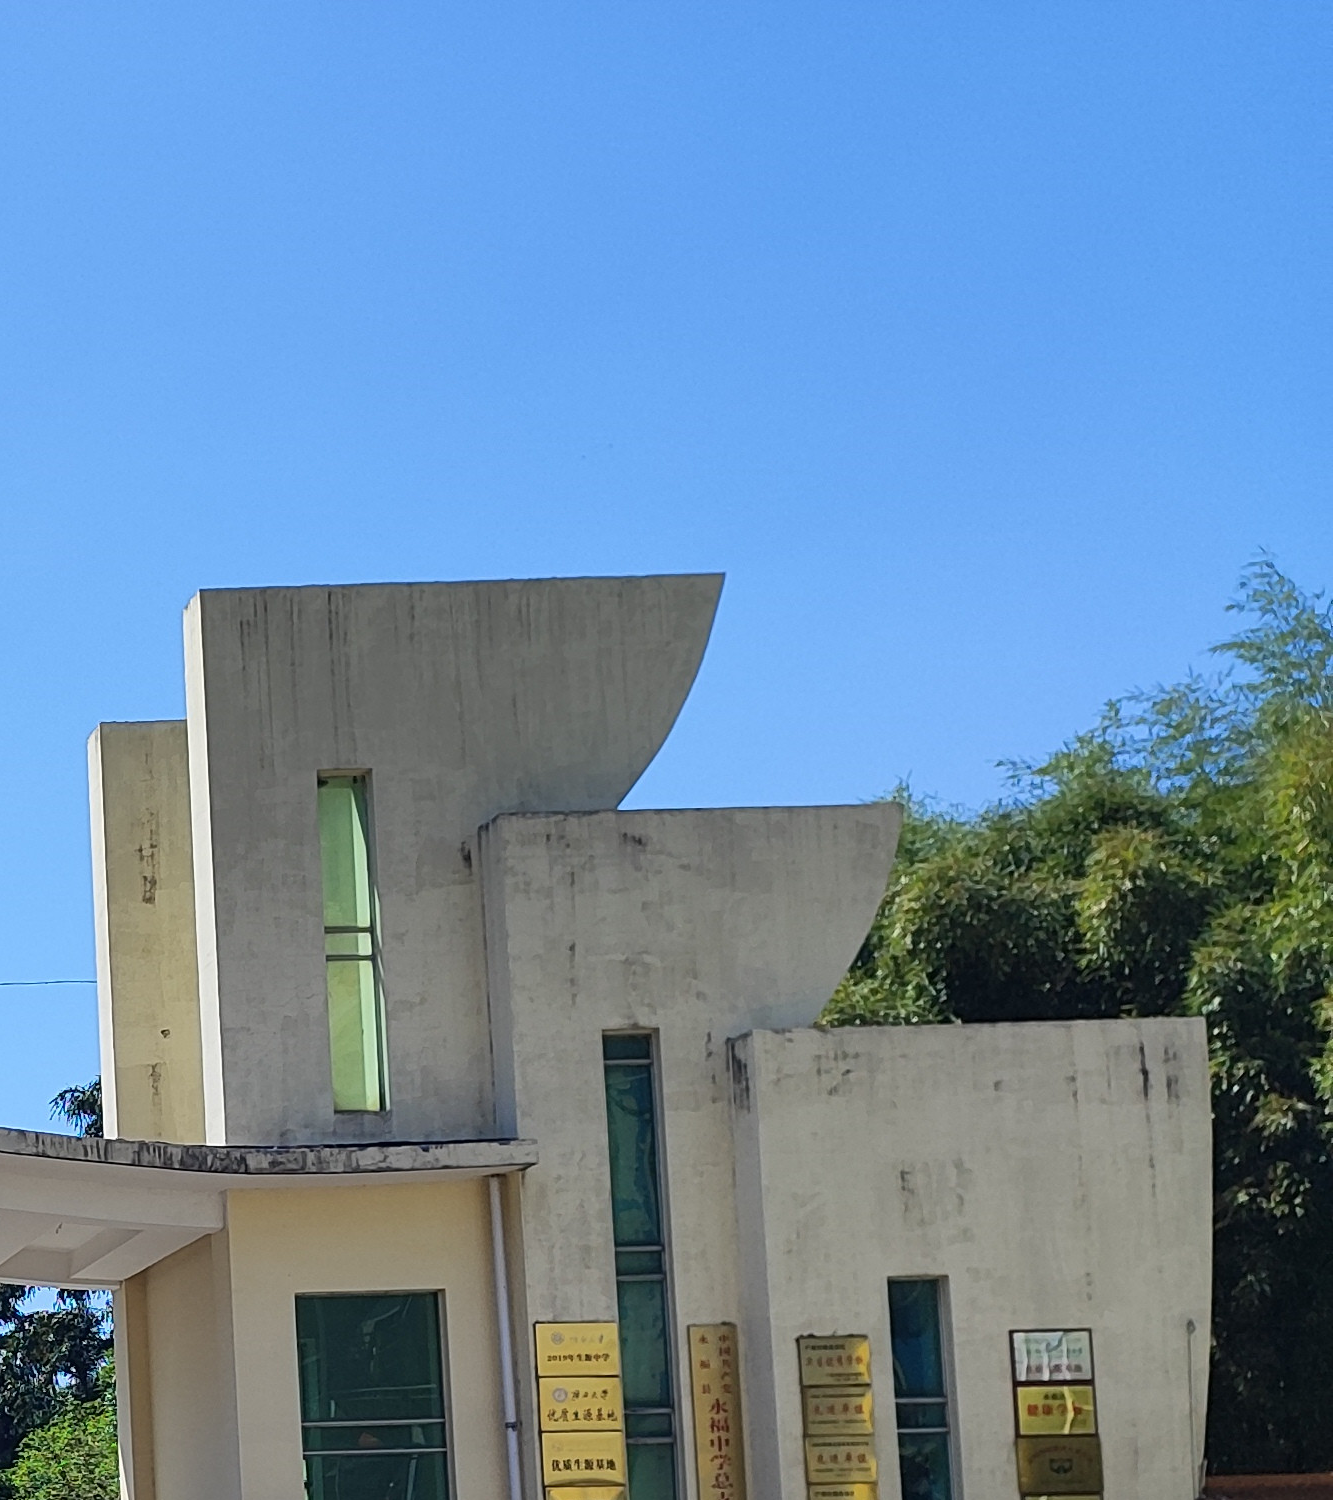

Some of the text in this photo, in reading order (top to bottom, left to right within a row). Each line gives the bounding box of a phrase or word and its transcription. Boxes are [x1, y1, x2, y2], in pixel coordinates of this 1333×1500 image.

[551, 1458, 618, 1472] 优质生源基地
